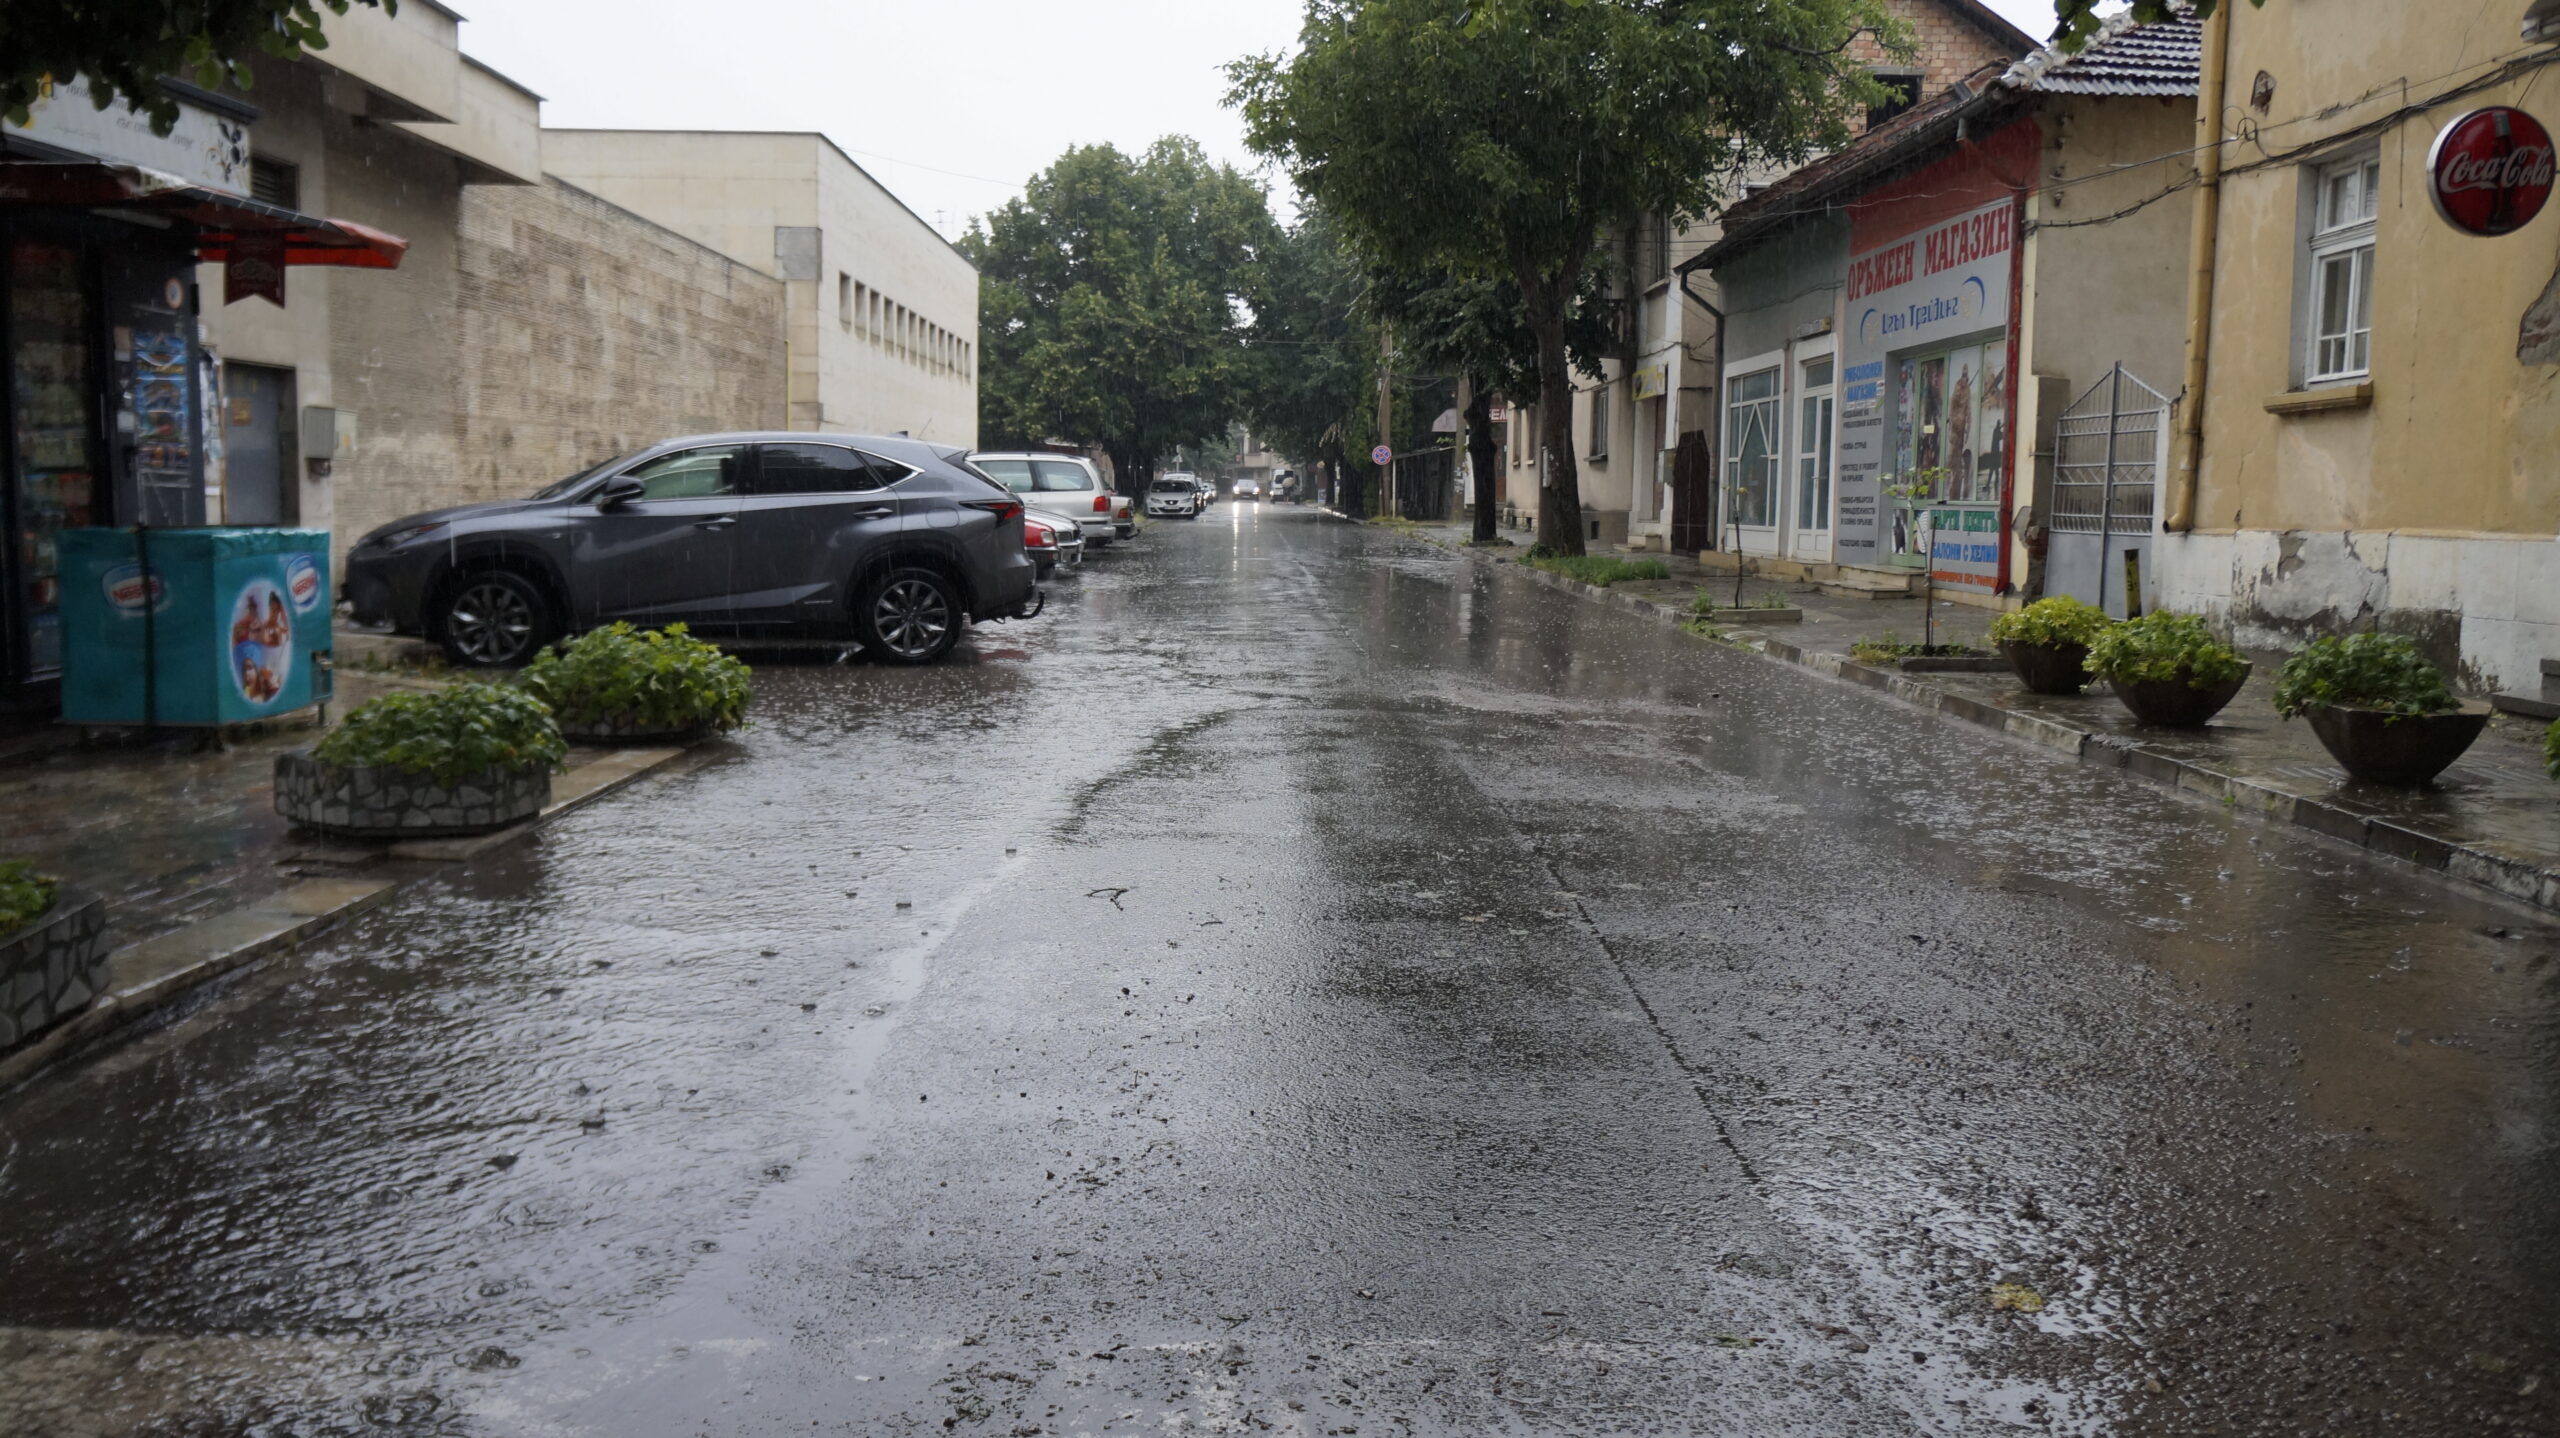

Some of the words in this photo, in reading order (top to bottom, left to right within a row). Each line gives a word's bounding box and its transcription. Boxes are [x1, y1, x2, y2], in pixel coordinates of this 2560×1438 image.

[2440, 145, 2551, 193] Coca-Cola
[1847, 241, 1915, 303] ОРЪЖЕЕН
[1924, 204, 2012, 277] МАГАЗИН
[1908, 296, 1959, 331] Трейдинг
[1846, 381, 1877, 402] МАГАЗИН
[1963, 510, 2000, 536] ЦЕНТЪ
[1932, 542, 1962, 560] БАЛОНИ
[1963, 544, 1969, 561] С
[1970, 541, 1998, 563] ХЕЛИЙ
